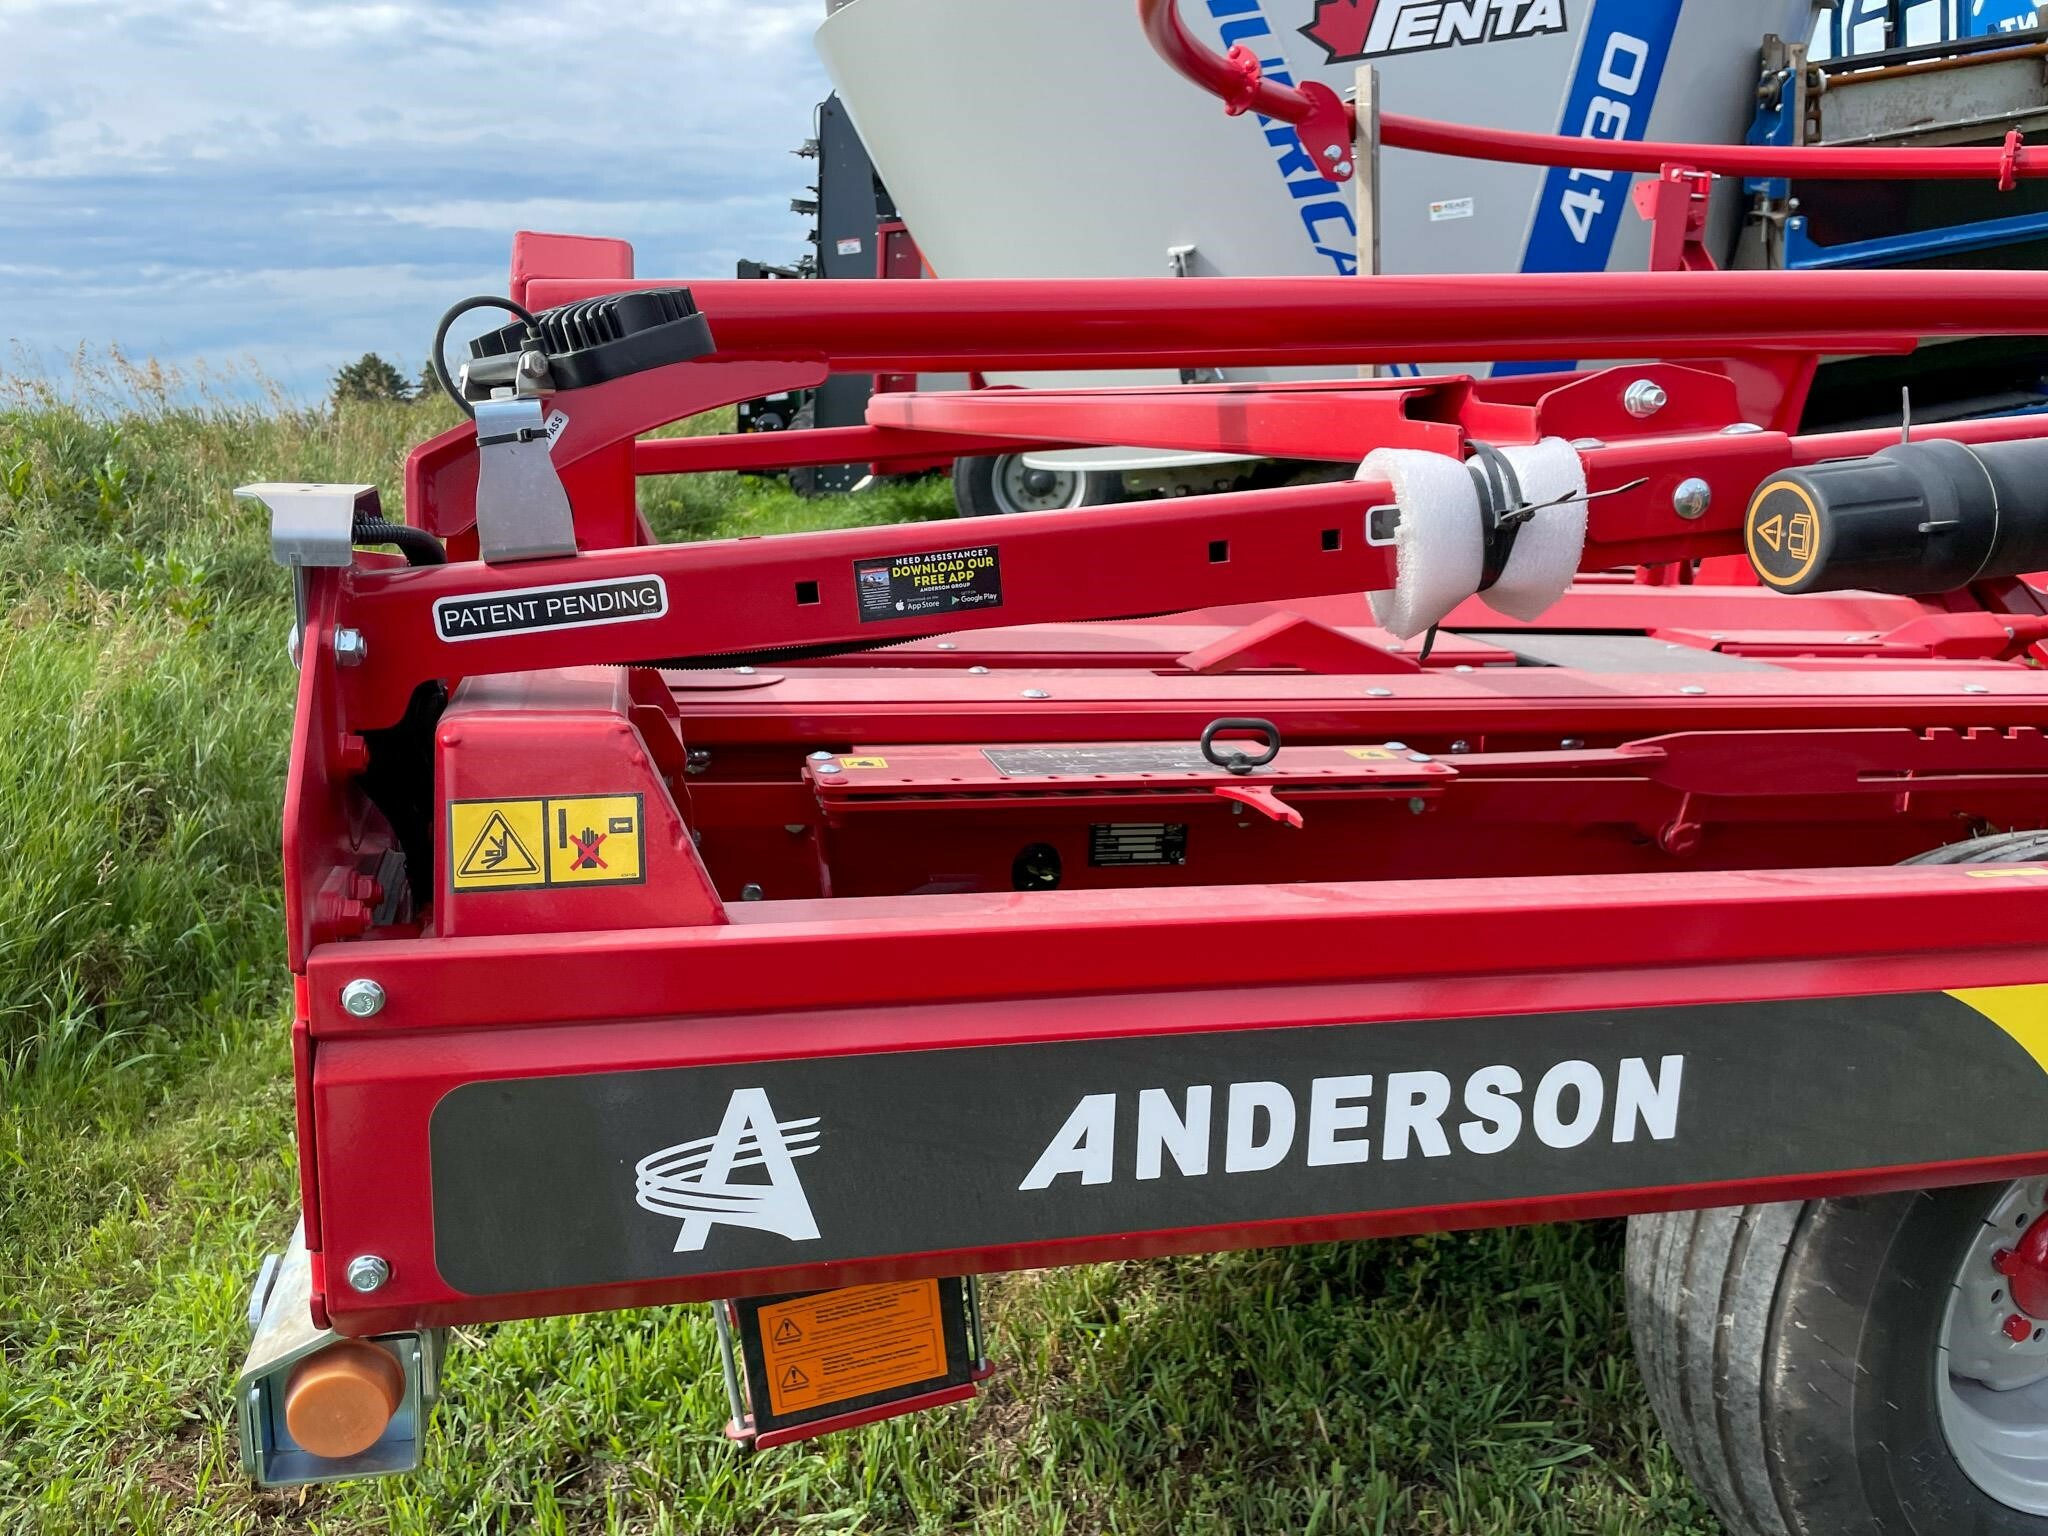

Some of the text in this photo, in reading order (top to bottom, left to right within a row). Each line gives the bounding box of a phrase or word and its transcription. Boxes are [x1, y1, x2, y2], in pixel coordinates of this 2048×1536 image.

[547, 416, 563, 440] PASS
[896, 549, 988, 566] NEED ASSISTANCE?
[892, 561, 964, 578] DOWNLOAD
[967, 557, 994, 569] OUR
[914, 571, 975, 587] FREE APP
[907, 600, 940, 611] App Store
[960, 594, 983, 603] Google
[983, 592, 998, 600] Play
[444, 588, 658, 629] PATENT PENDING
[1018, 1054, 1684, 1191] ANDERSON
